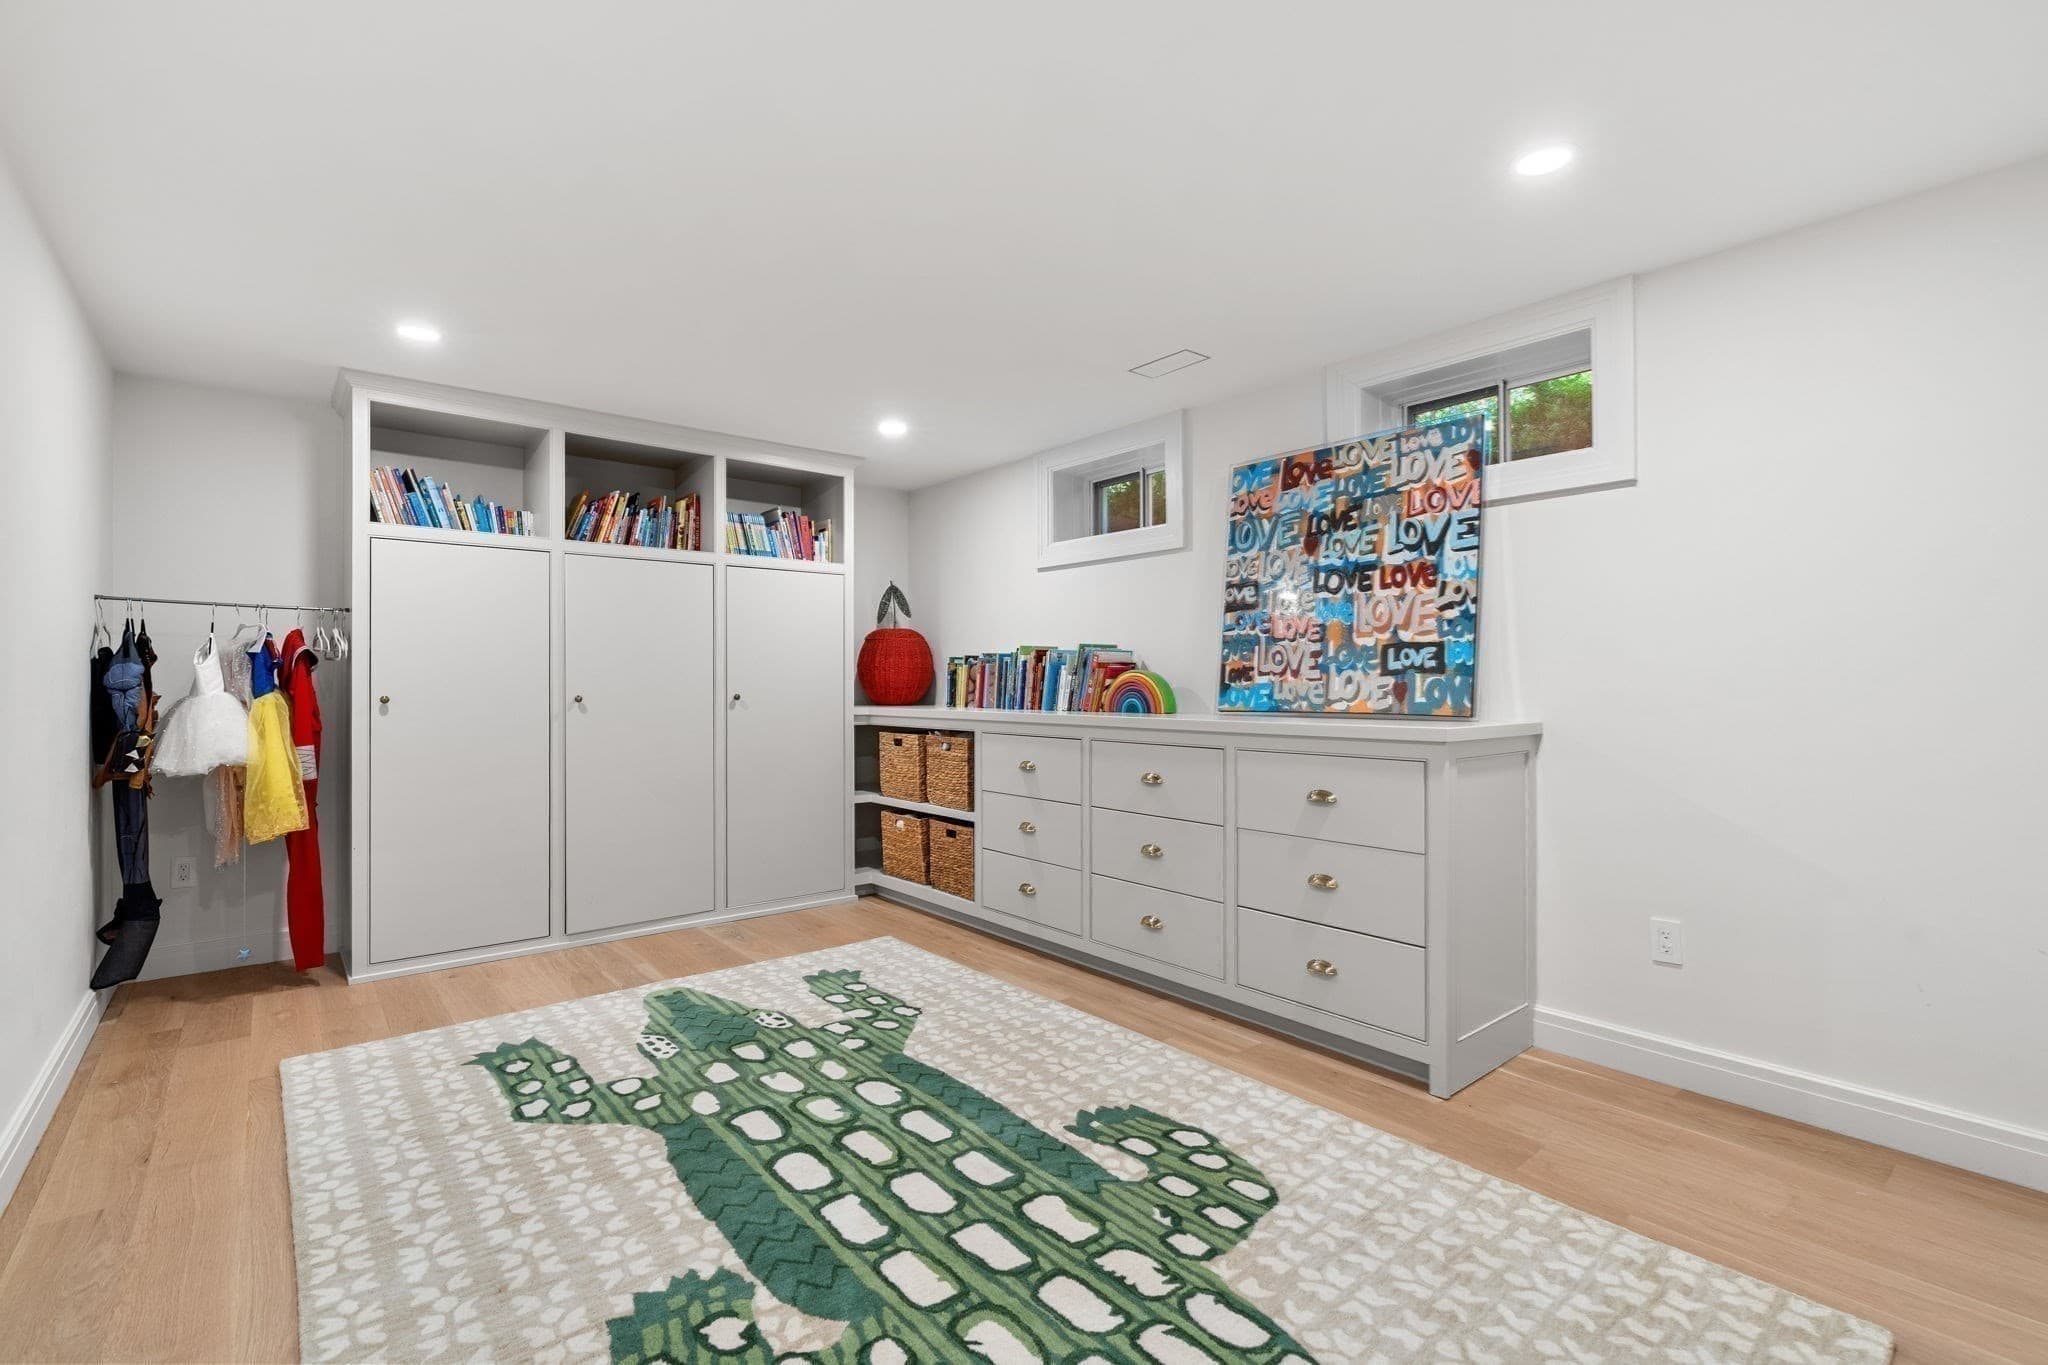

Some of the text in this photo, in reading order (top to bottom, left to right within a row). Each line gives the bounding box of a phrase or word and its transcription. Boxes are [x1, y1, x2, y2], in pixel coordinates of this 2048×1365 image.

[1331, 434, 1396, 468] LOVE
[1390, 443, 1470, 490] LOVE
[1227, 512, 1305, 556] LOVE
[1308, 502, 1362, 535] LOVE
[1386, 508, 1480, 557] LOVE
[1319, 523, 1384, 560] LOVE
[1312, 566, 1377, 595] LOVE
[1270, 615, 1325, 642] LOVE
[1353, 590, 1441, 640] LOVE
[1253, 637, 1323, 682] LOVE
[1387, 646, 1437, 671] LOVE
[1326, 664, 1395, 708] LOVE
